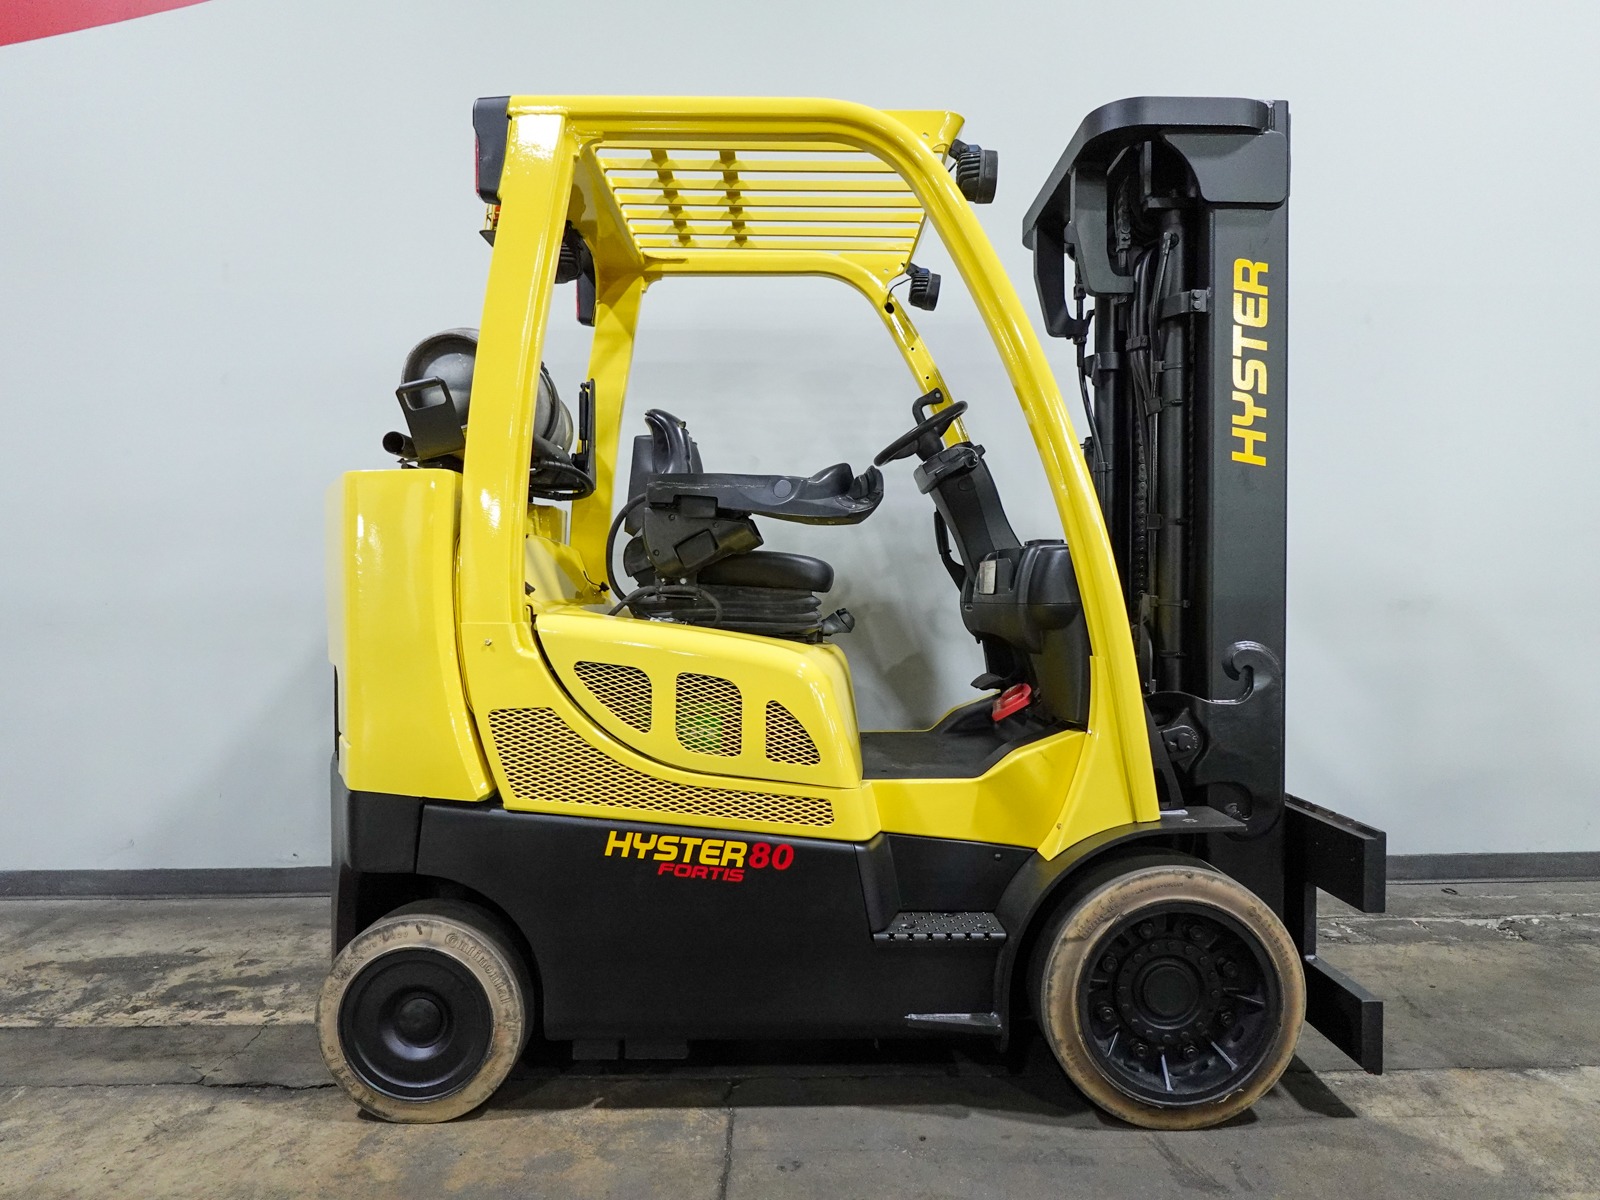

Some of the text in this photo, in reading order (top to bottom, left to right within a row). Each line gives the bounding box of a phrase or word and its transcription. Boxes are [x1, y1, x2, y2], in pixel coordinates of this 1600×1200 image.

[1231, 258, 1269, 467] HYSTER
[604, 830, 795, 871] HYSTER 80
[657, 862, 746, 883] FORTIS
